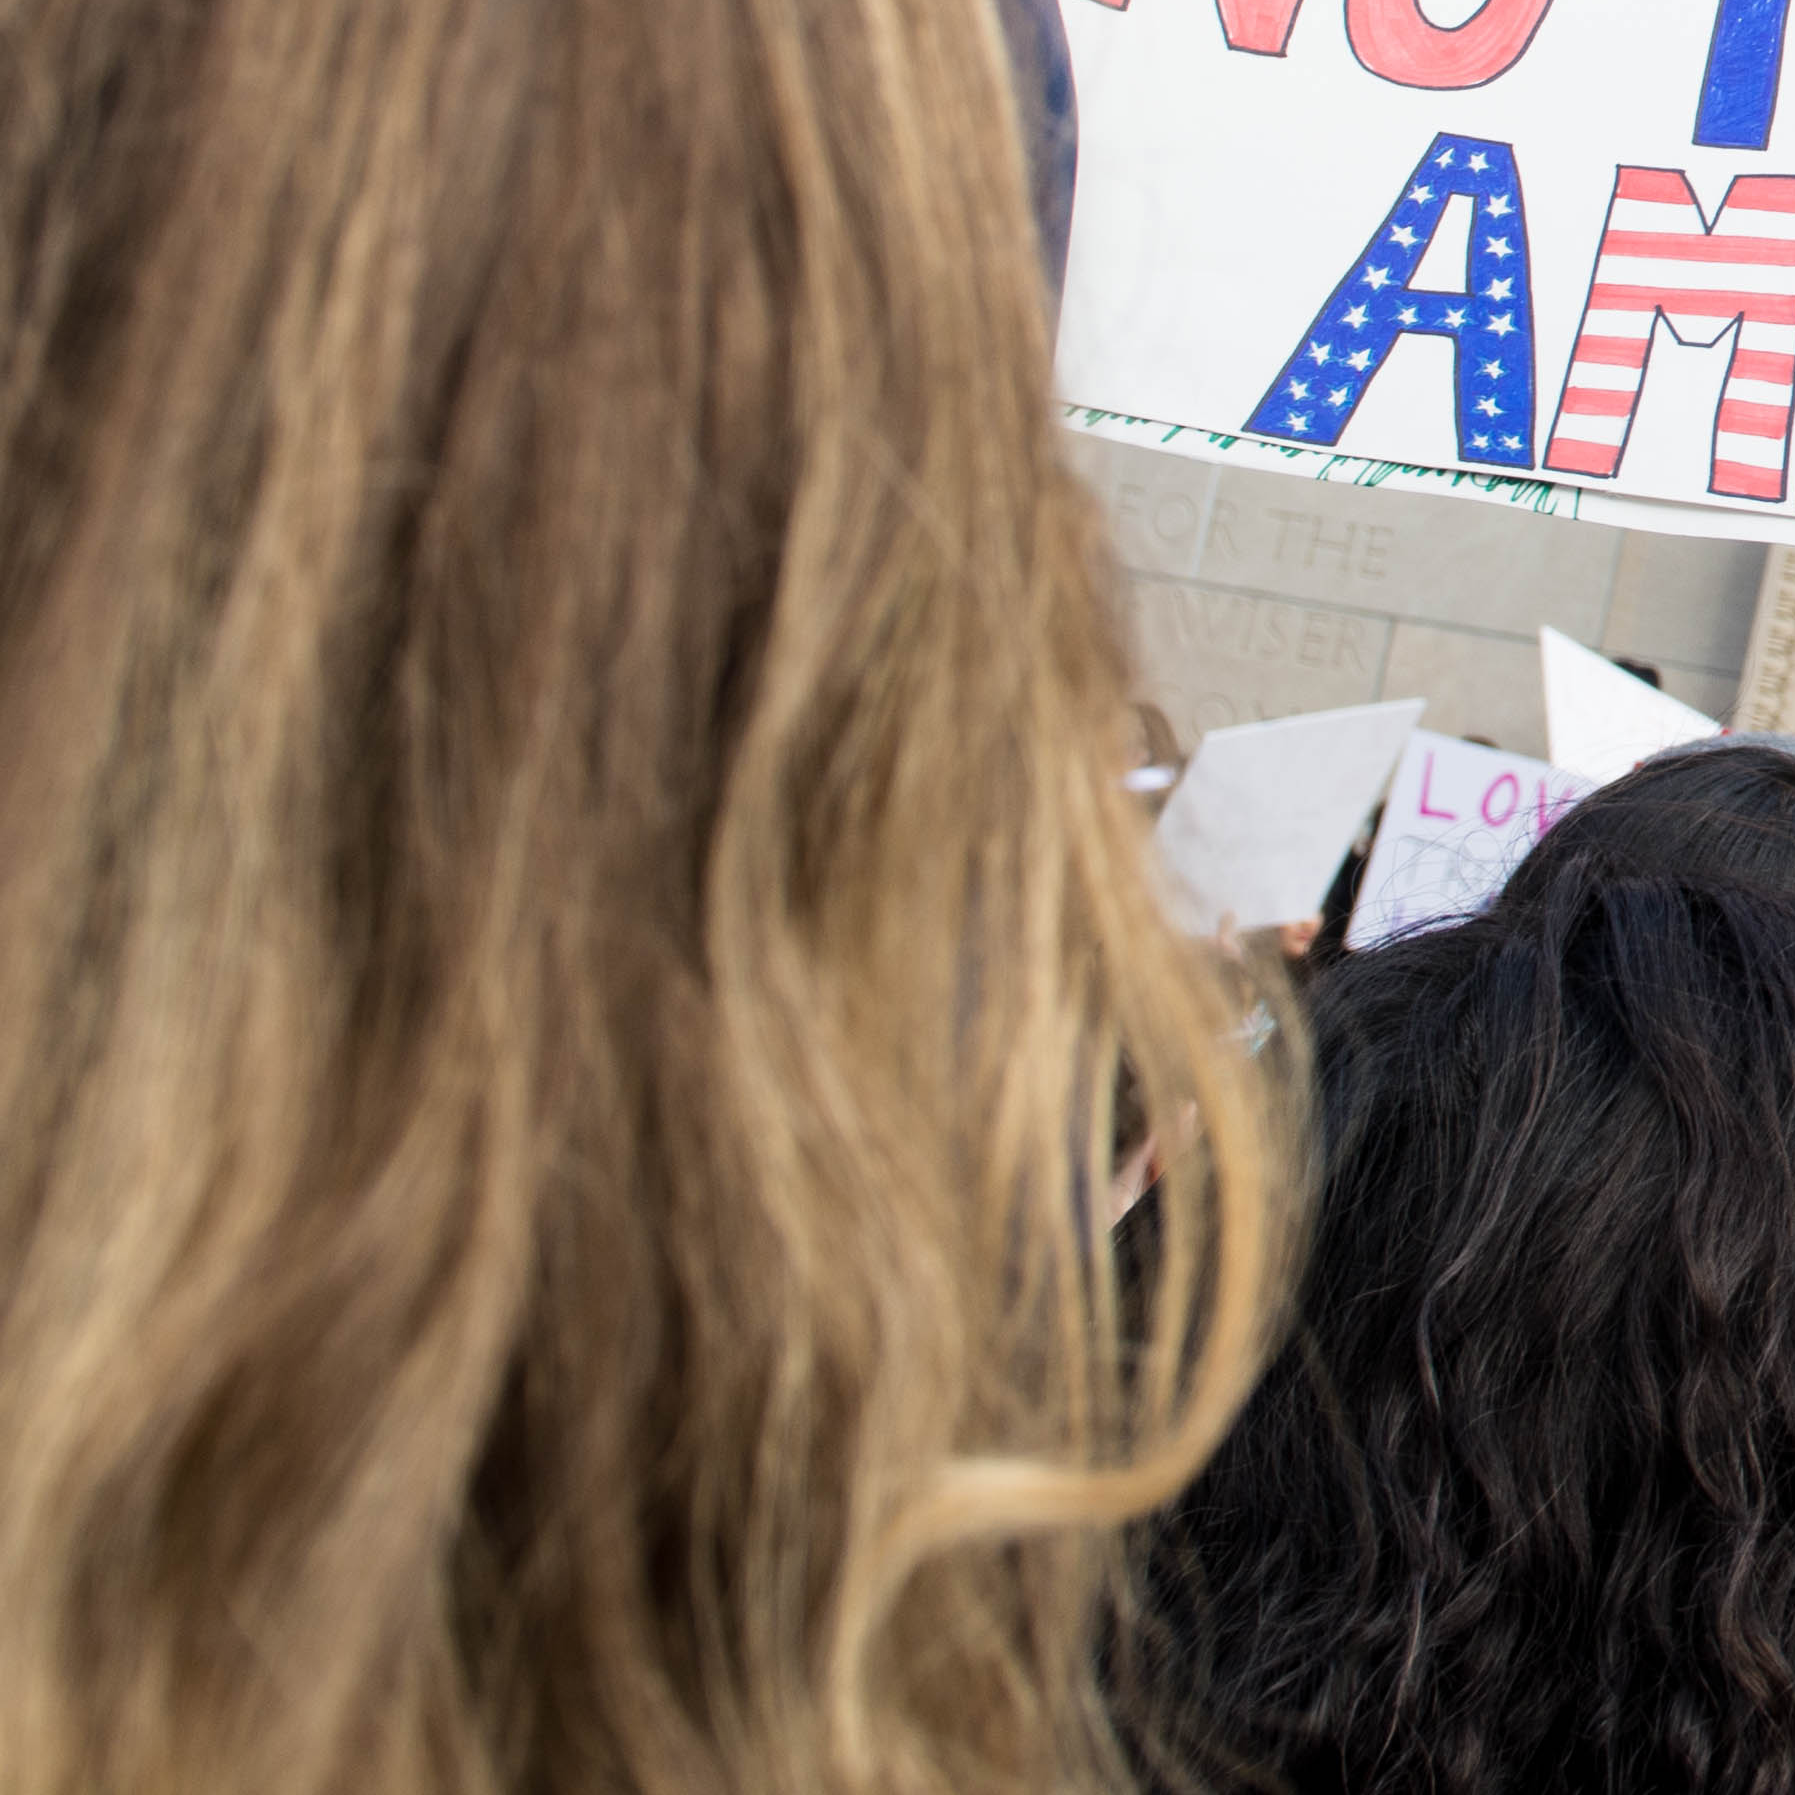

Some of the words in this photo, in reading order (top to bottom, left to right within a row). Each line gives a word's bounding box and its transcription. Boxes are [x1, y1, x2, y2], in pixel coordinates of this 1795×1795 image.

[1112, 480, 1244, 562] FOR
[1263, 506, 1398, 582] THE
[1418, 750, 1577, 842] LOV
